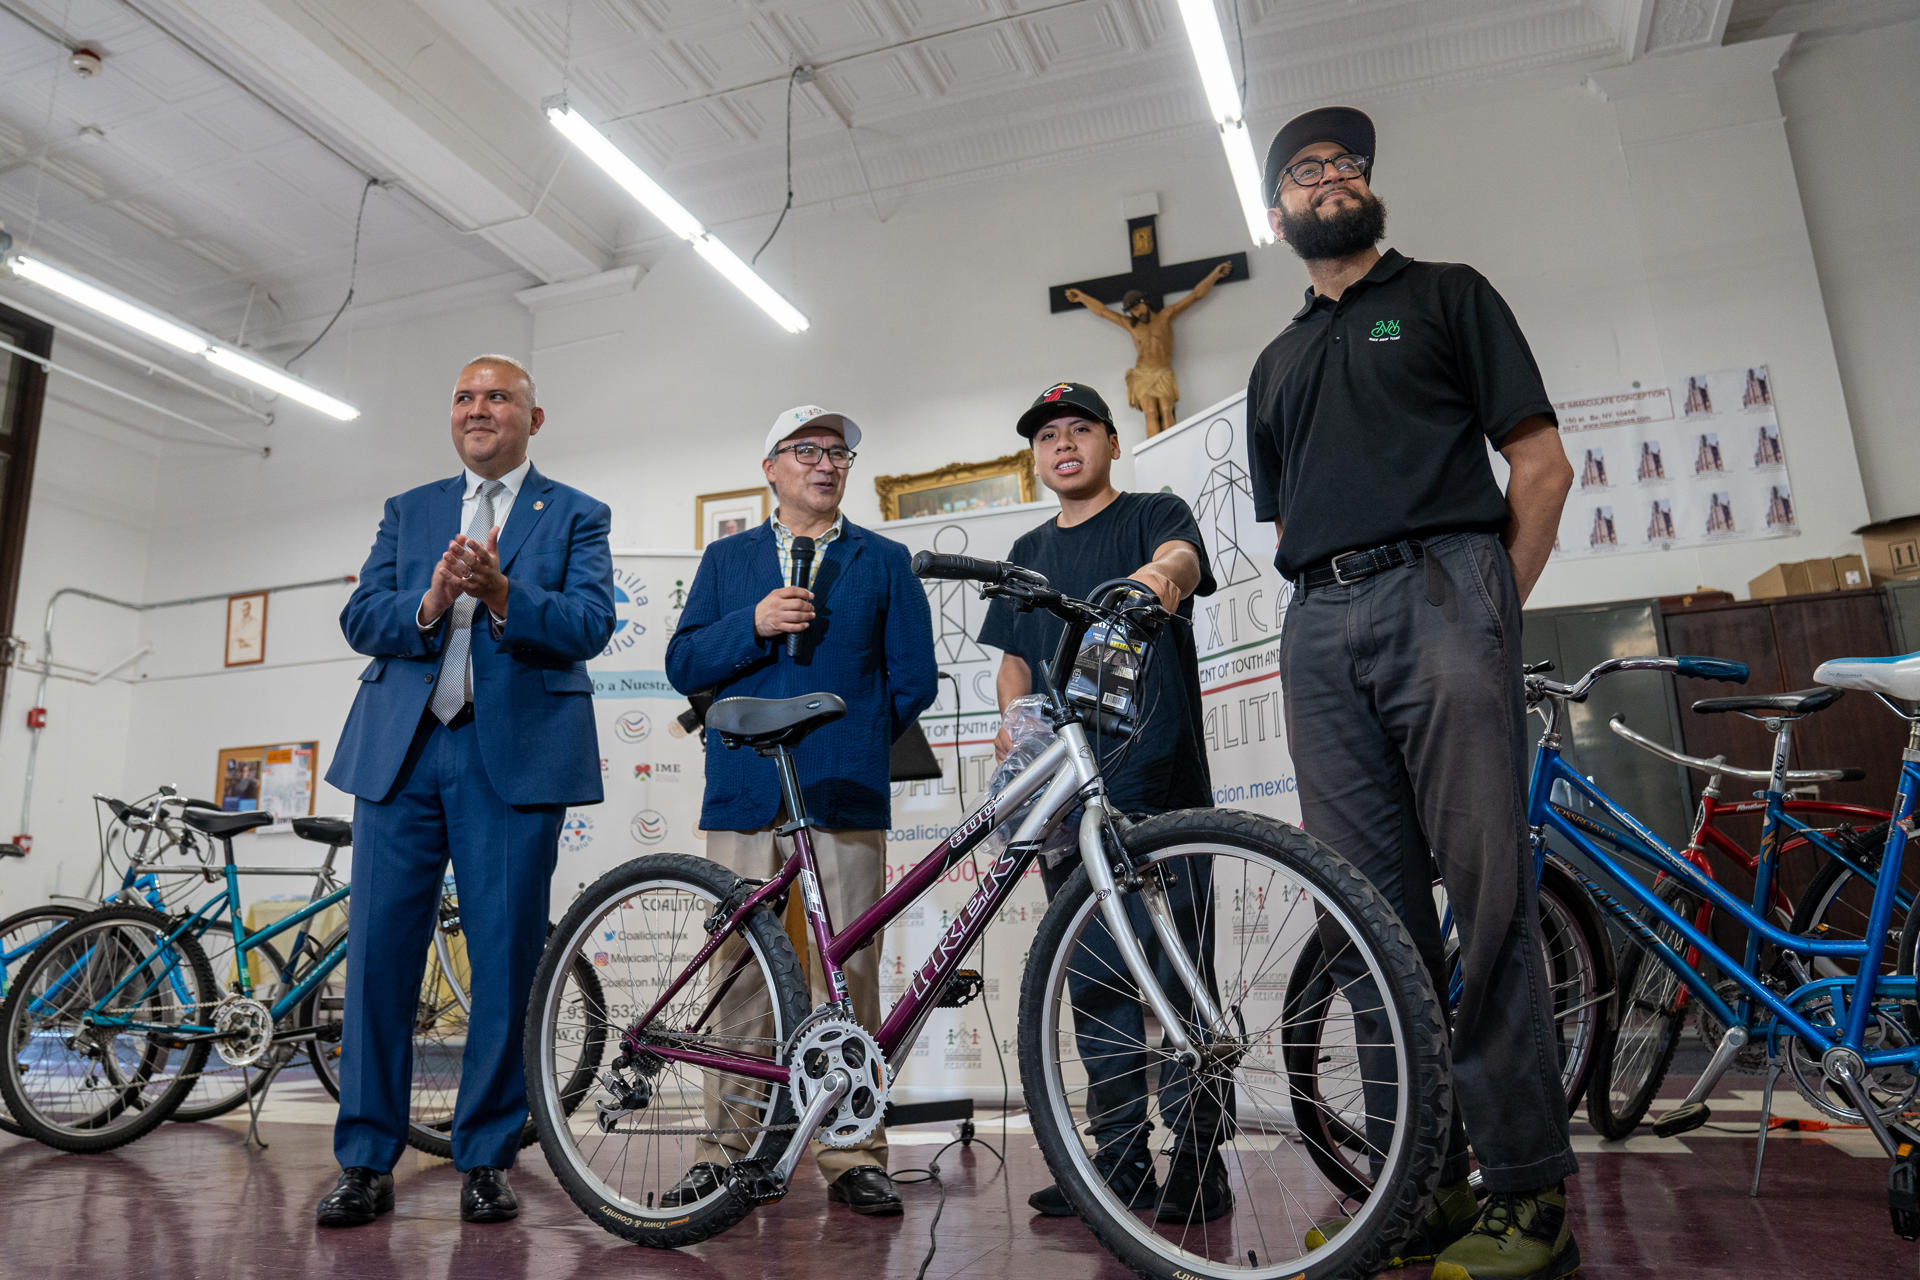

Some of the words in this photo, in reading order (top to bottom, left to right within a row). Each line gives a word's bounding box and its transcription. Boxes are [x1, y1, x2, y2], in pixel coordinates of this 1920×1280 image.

[1231, 653, 1263, 674] YOUTH
[655, 763, 681, 774] IME
[1775, 753, 1785, 781] UNO
[950, 799, 996, 848] 800
[904, 848, 1016, 1001] TREK
[600, 1206, 632, 1225] Country
[634, 1220, 641, 1228] &
